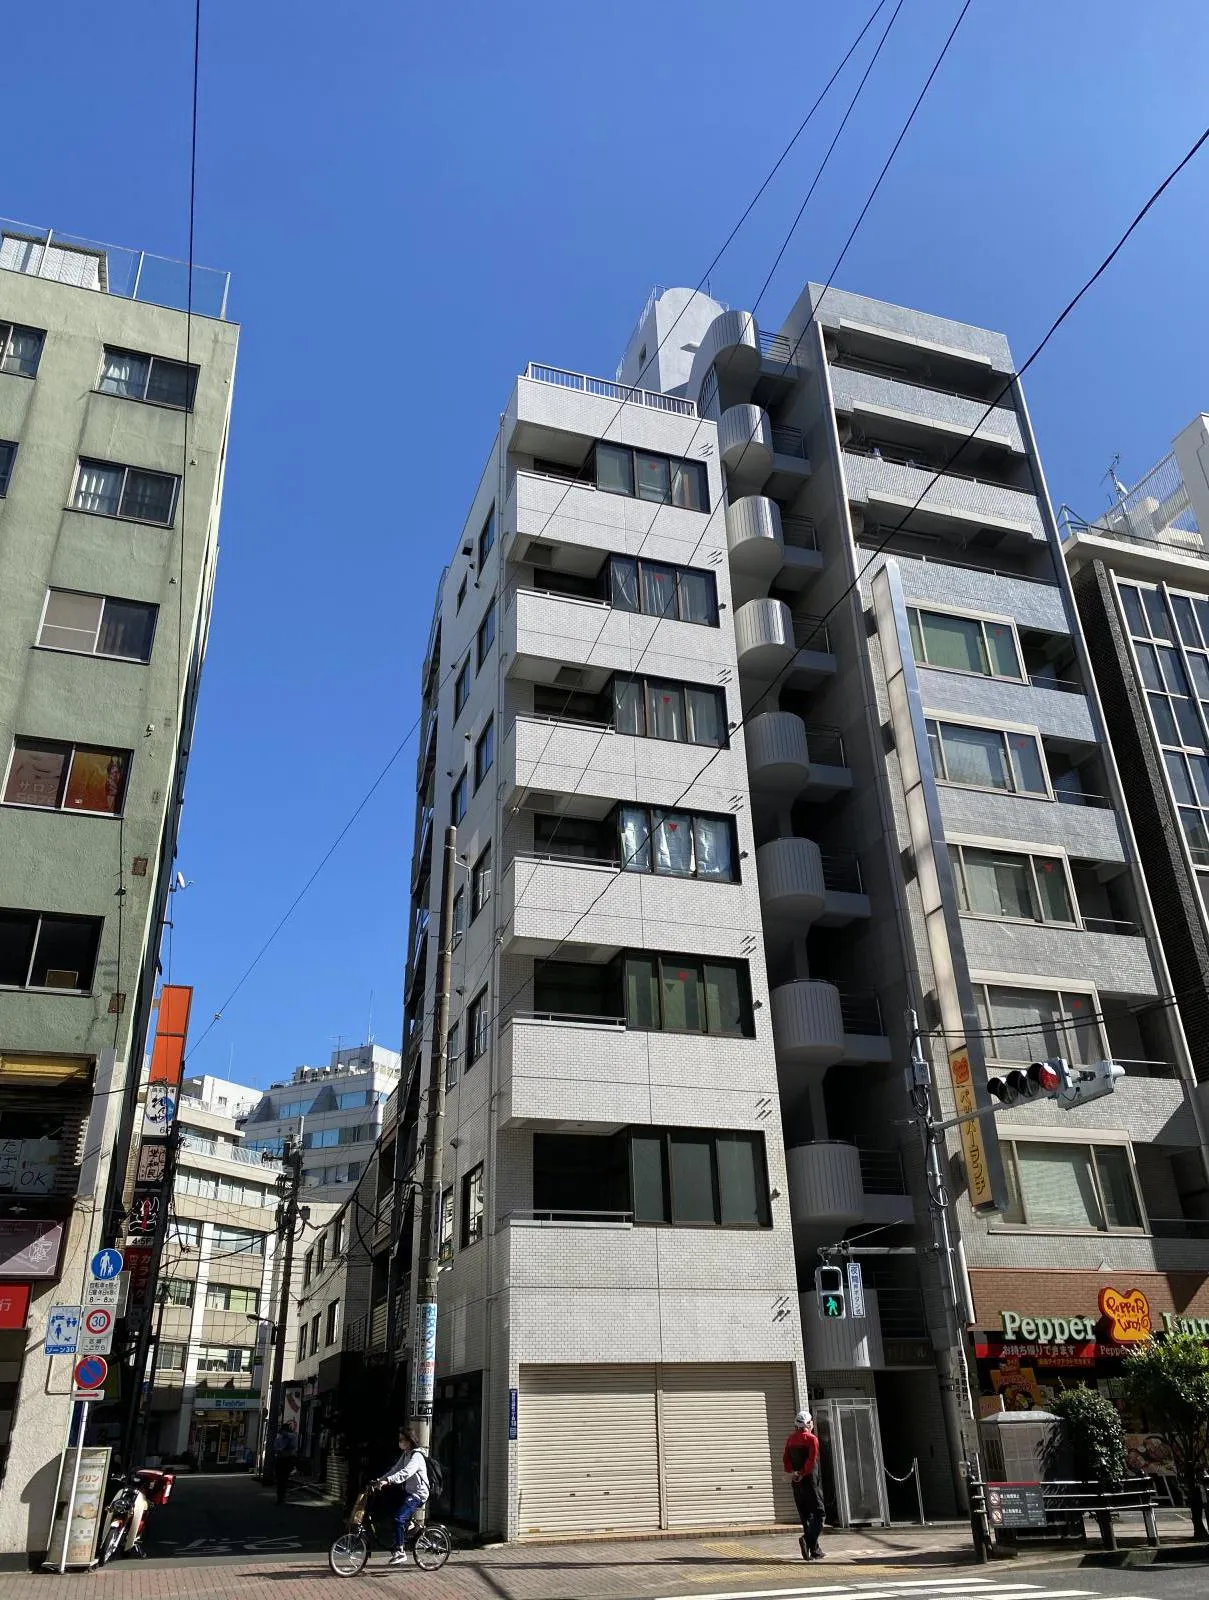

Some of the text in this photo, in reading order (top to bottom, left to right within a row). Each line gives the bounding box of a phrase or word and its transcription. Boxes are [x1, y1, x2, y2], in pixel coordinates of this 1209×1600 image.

[20, 781, 57, 793] サロン
[21, 1171, 48, 1187] OK
[91, 1316, 106, 1328] 30
[1000, 1311, 1096, 1344] Pepper
[46, 1346, 75, 1354] ゾーン30
